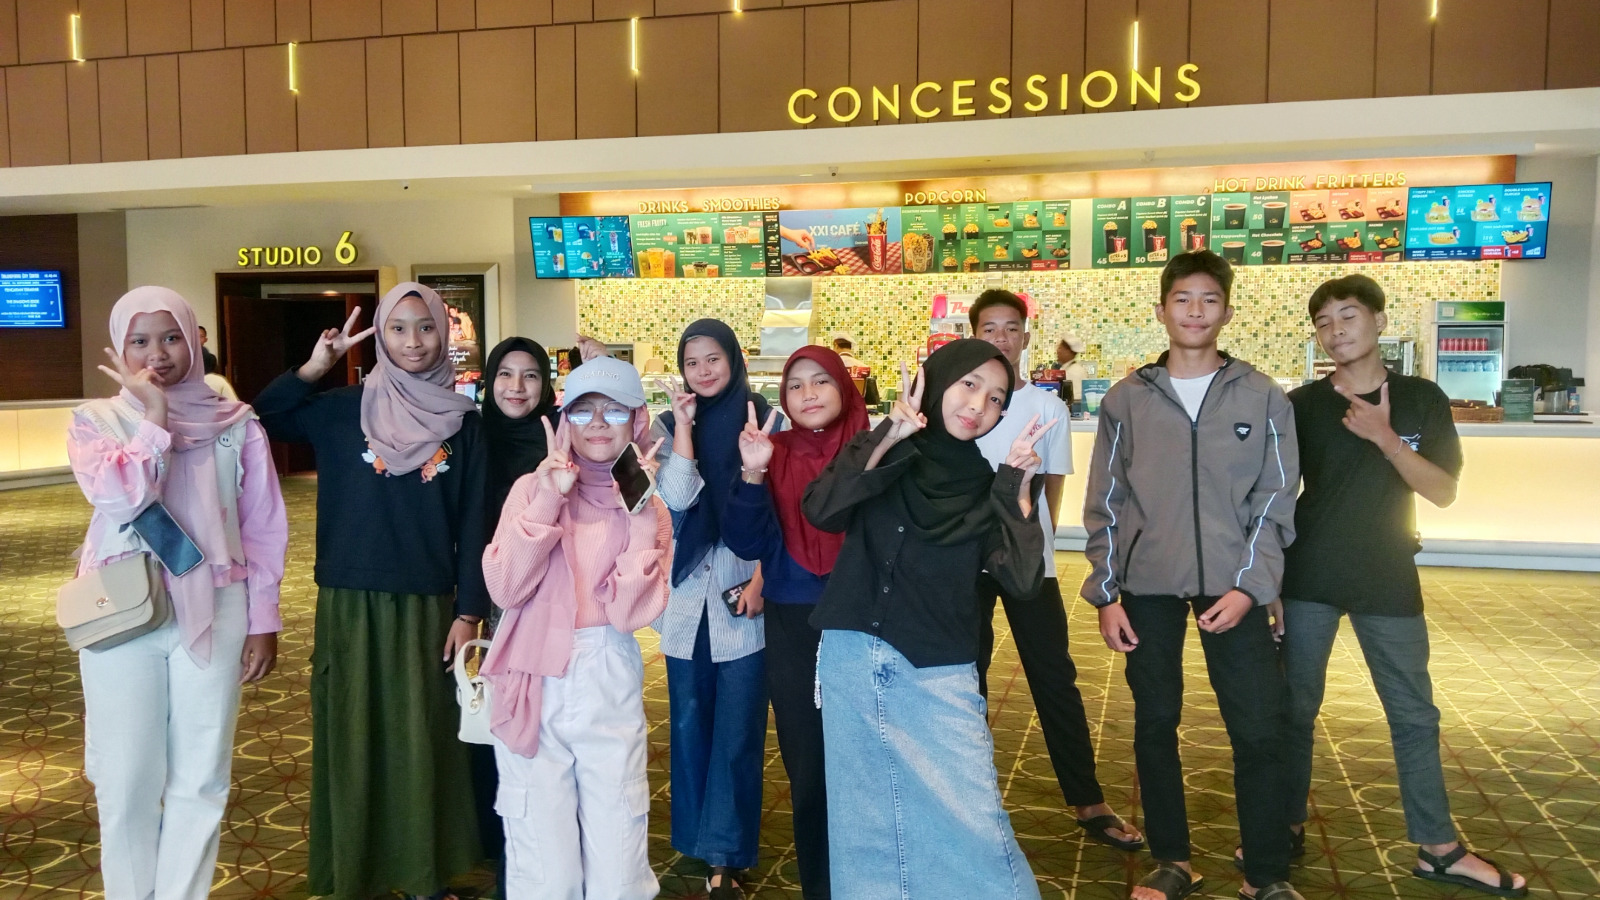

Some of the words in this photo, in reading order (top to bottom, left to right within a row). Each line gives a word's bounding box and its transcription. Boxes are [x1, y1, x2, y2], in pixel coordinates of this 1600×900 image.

[787, 63, 1201, 125] CONCESSIONS
[1214, 177, 1250, 193] HOT
[1256, 175, 1305, 191] DRINK
[1316, 172, 1407, 188] FRITTERS
[702, 197, 781, 212] SMOOTHIES
[905, 189, 986, 205] POPCORN
[1157, 198, 1166, 208] B
[1196, 196, 1206, 206] C
[638, 200, 689, 214] DRINKS
[1117, 200, 1127, 210] A
[809, 225, 828, 236] XXI
[830, 221, 861, 235] CAFÉ
[237, 246, 322, 267] STUDIO
[335, 231, 358, 266] 6
